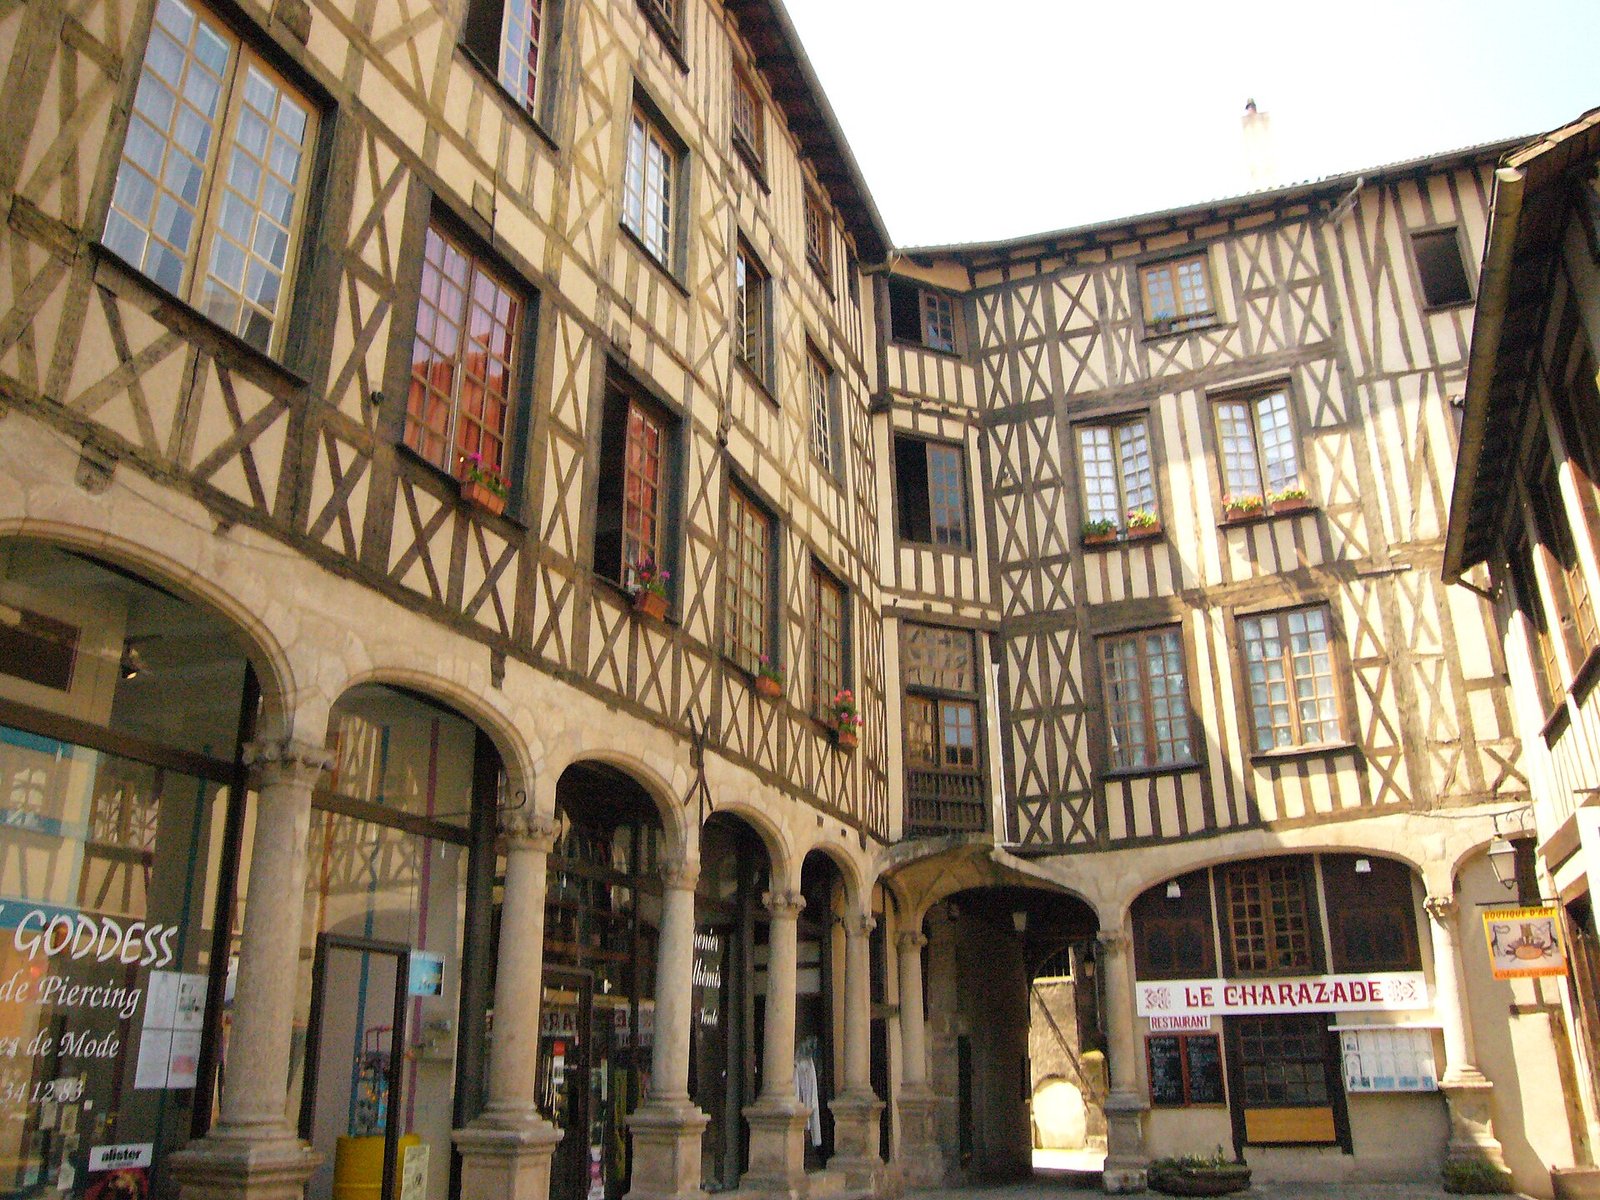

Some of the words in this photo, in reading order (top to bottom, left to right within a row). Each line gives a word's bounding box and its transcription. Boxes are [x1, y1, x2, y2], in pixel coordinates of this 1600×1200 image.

[1484, 909, 1526, 920] BOUTIQUE
[14, 910, 178, 968] GODDESS
[0, 968, 29, 1003] de
[36, 975, 142, 1020] Piercing
[1185, 987, 1215, 1008] LE
[1223, 980, 1385, 1007] CHARAZADE
[1151, 1015, 1209, 1029] RESTAURANT
[26, 1027, 53, 1057] de
[58, 1029, 120, 1059] Mode
